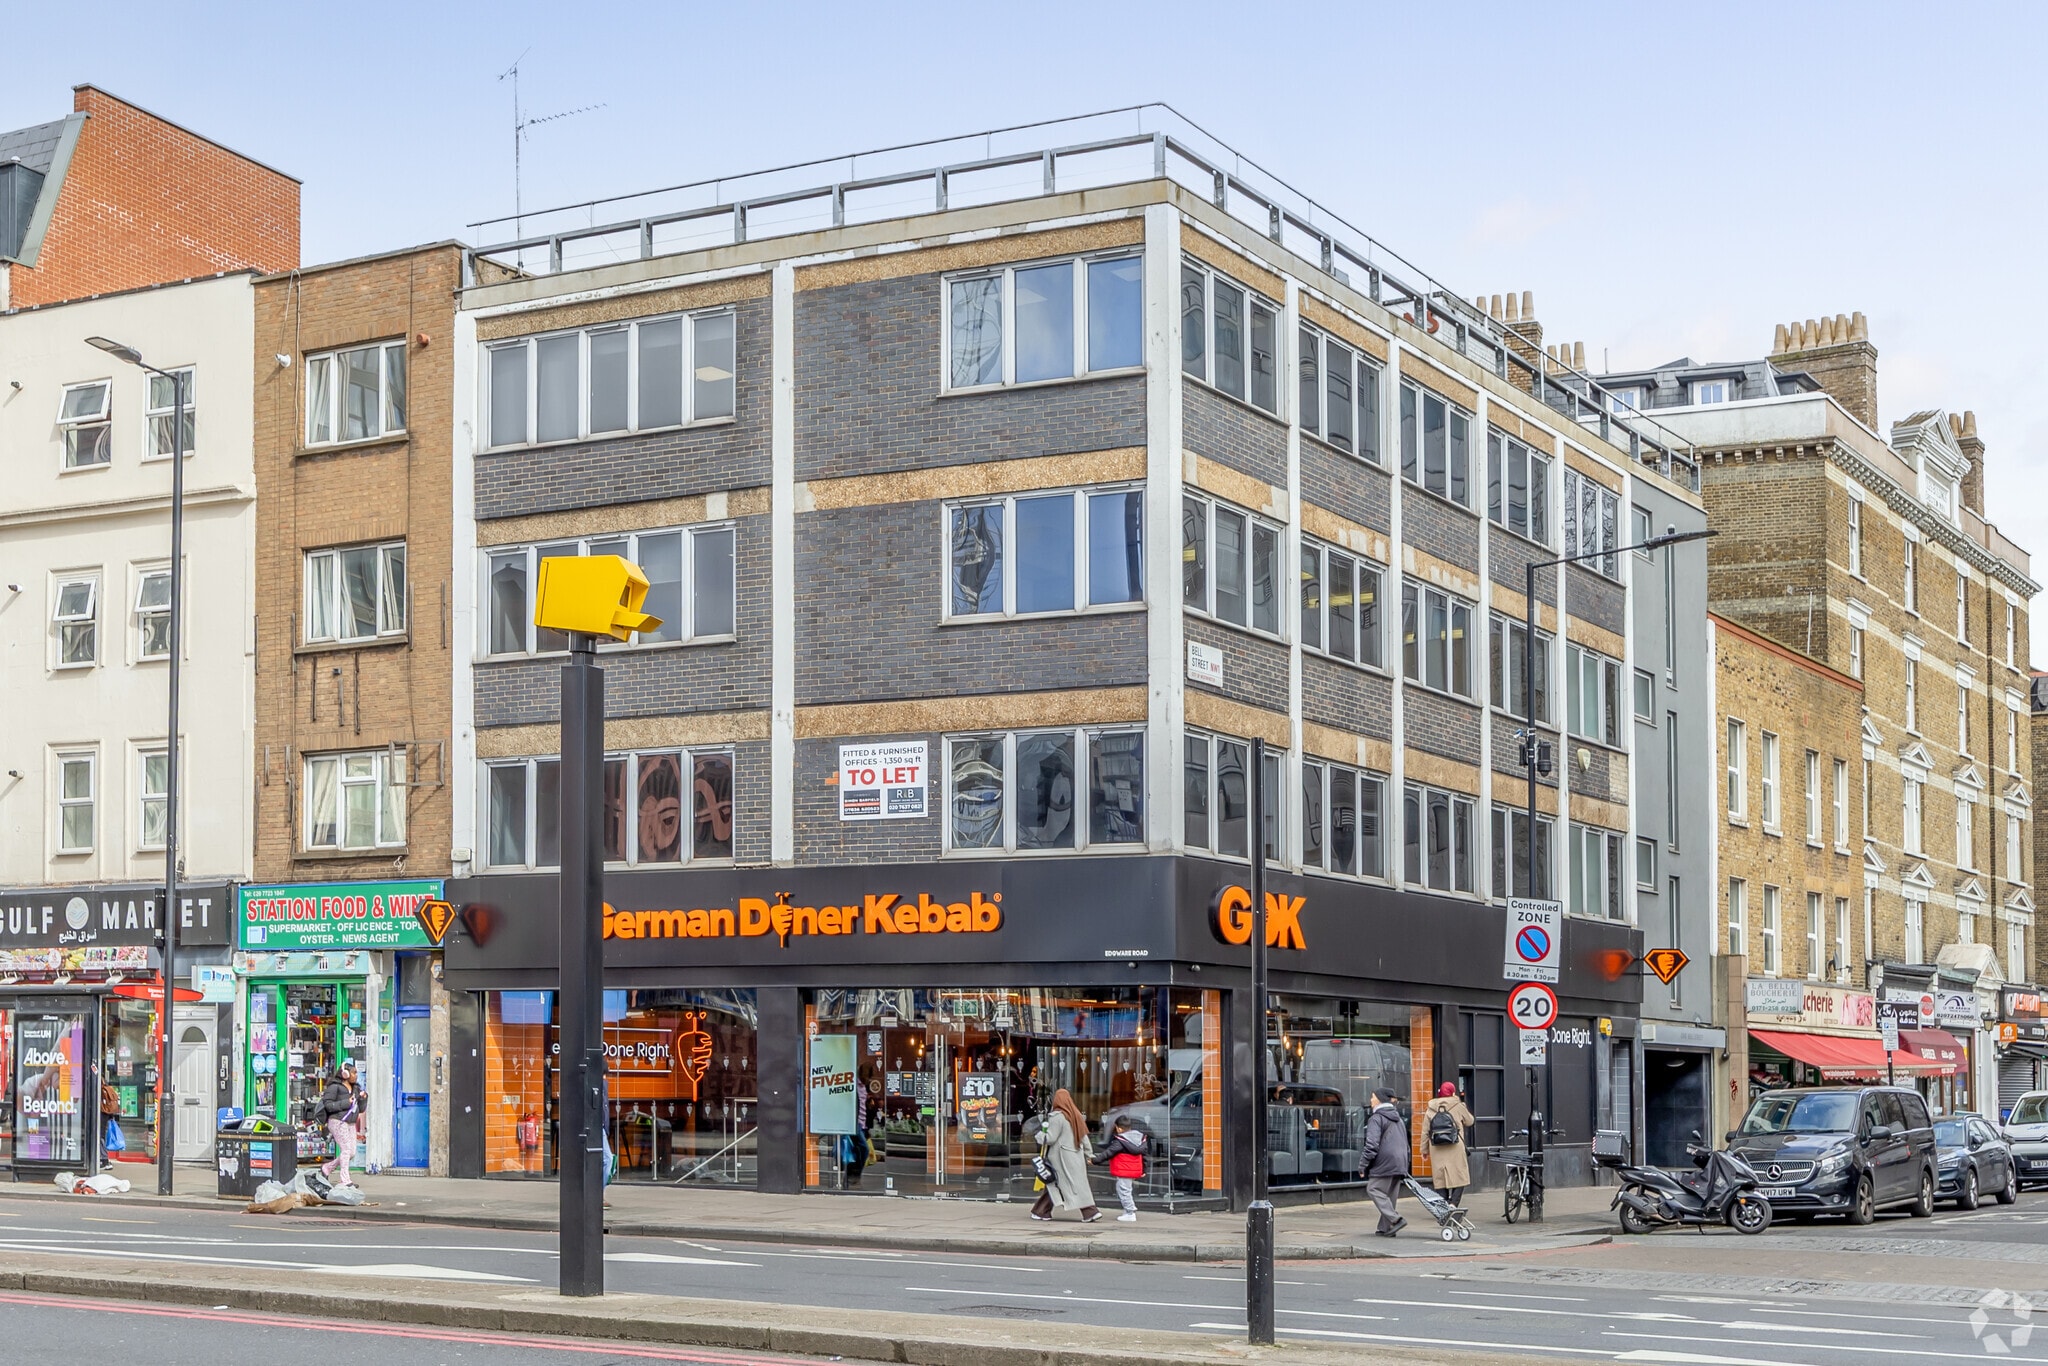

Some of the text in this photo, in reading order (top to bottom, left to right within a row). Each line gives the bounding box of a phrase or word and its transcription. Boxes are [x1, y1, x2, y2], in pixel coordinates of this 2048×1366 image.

[1191, 645, 1202, 657] BELL
[1191, 657, 1220, 673] STREET NW1
[843, 749, 870, 757] FITTED
[879, 746, 924, 755] FURNISHED
[845, 758, 878, 766] OFFICES
[884, 757, 903, 765] 1,350
[915, 755, 922, 763] ft
[847, 766, 920, 785] TO LET
[247, 893, 434, 921] STATION FOOD & WIN
[1511, 900, 1559, 912] Controlled
[0, 898, 212, 934] ULF MARET
[1517, 911, 1551, 924] ZONE
[268, 923, 331, 934] SUPERMARKET
[337, 922, 354, 932] OFF
[300, 934, 334, 944] OYSTER
[342, 934, 368, 944] NEWS
[368, 933, 400, 943] AGENT
[1104, 949, 1131, 957] EDGWARE
[1750, 989, 1798, 997] BOUCHERIE
[1516, 997, 1551, 1017] 20
[409, 1043, 425, 1056] 314
[23, 1048, 69, 1065] Above.
[811, 1065, 833, 1076] NEW
[828, 1084, 855, 1095] MENU
[965, 1080, 995, 1097] £10
[23, 1095, 78, 1118] Beyond.
